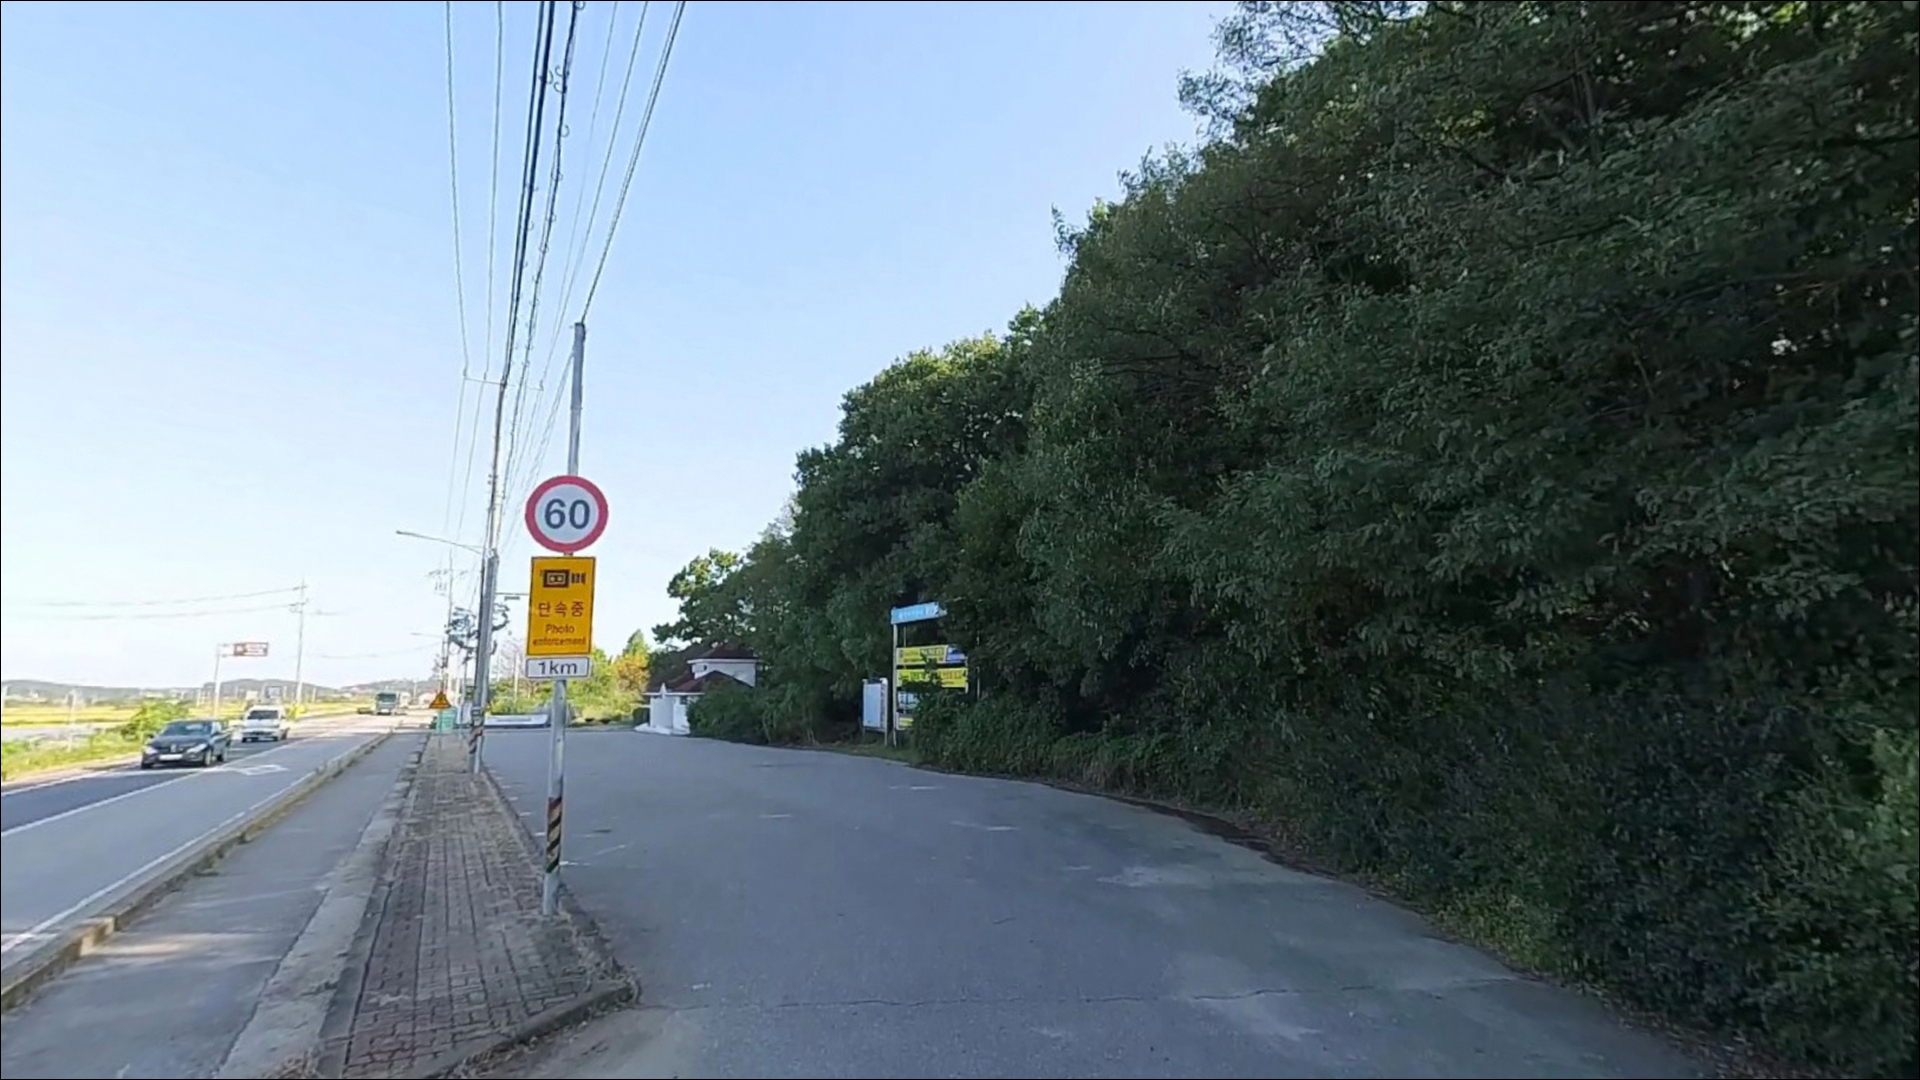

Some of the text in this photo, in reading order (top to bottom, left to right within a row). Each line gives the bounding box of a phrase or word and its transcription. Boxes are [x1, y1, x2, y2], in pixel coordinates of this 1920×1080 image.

[544, 498, 590, 530] 60
[538, 601, 584, 618] 단속중
[545, 624, 575, 635] Photo
[532, 637, 586, 647] enforcement
[538, 660, 578, 675] 1km
